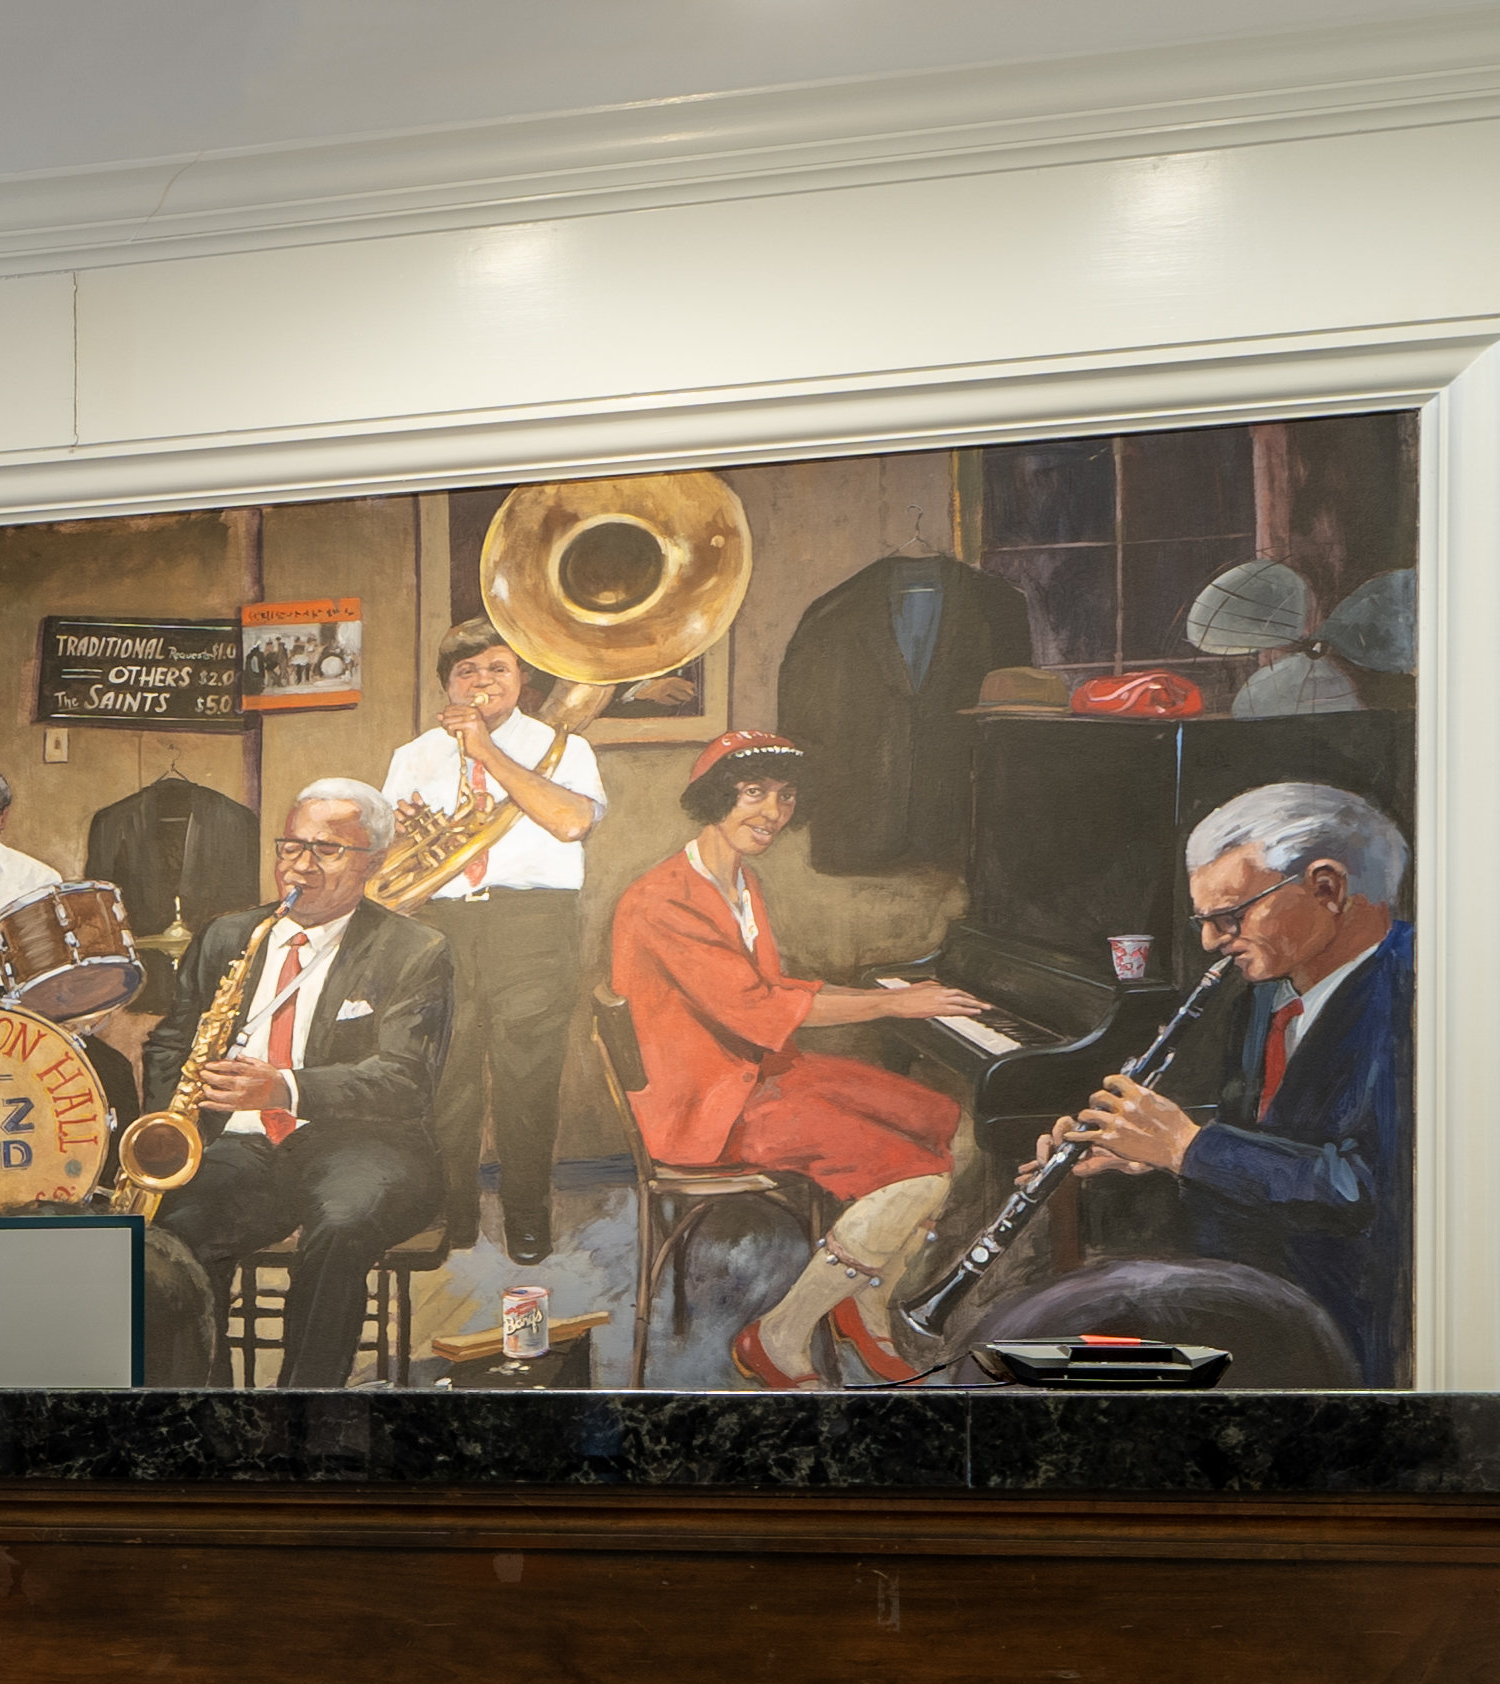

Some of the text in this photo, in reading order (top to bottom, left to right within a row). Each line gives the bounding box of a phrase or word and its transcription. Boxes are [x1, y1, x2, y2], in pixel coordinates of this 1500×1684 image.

[56, 635, 165, 660] TRADITIONAL
[108, 665, 193, 687] OTHERS
[54, 691, 79, 708] The
[84, 684, 171, 713] SAINTS
[36, 1051, 99, 1154] HALL
